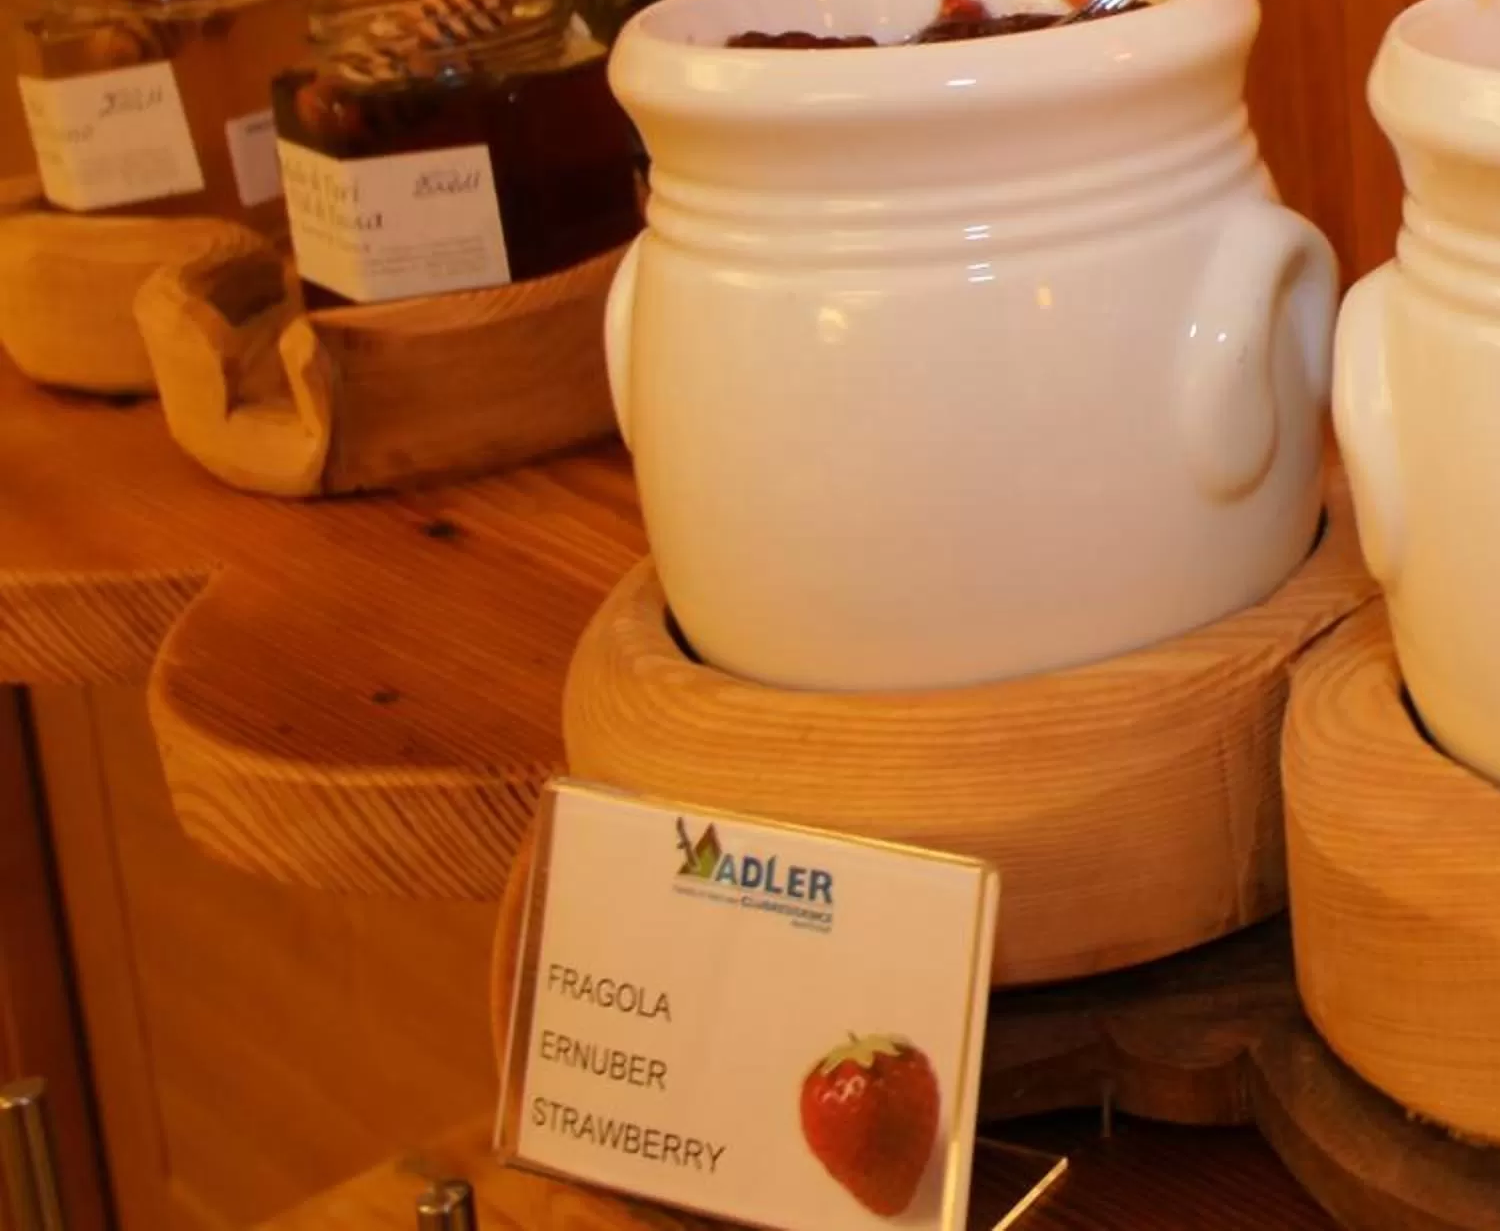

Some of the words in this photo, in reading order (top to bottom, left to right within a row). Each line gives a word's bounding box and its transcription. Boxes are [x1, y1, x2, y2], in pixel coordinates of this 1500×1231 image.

[715, 852, 833, 904] ADLER
[547, 963, 672, 1022] FRAGOLA
[540, 1030, 668, 1090] ERNUBER
[531, 1096, 727, 1173] STRAWBERRY
